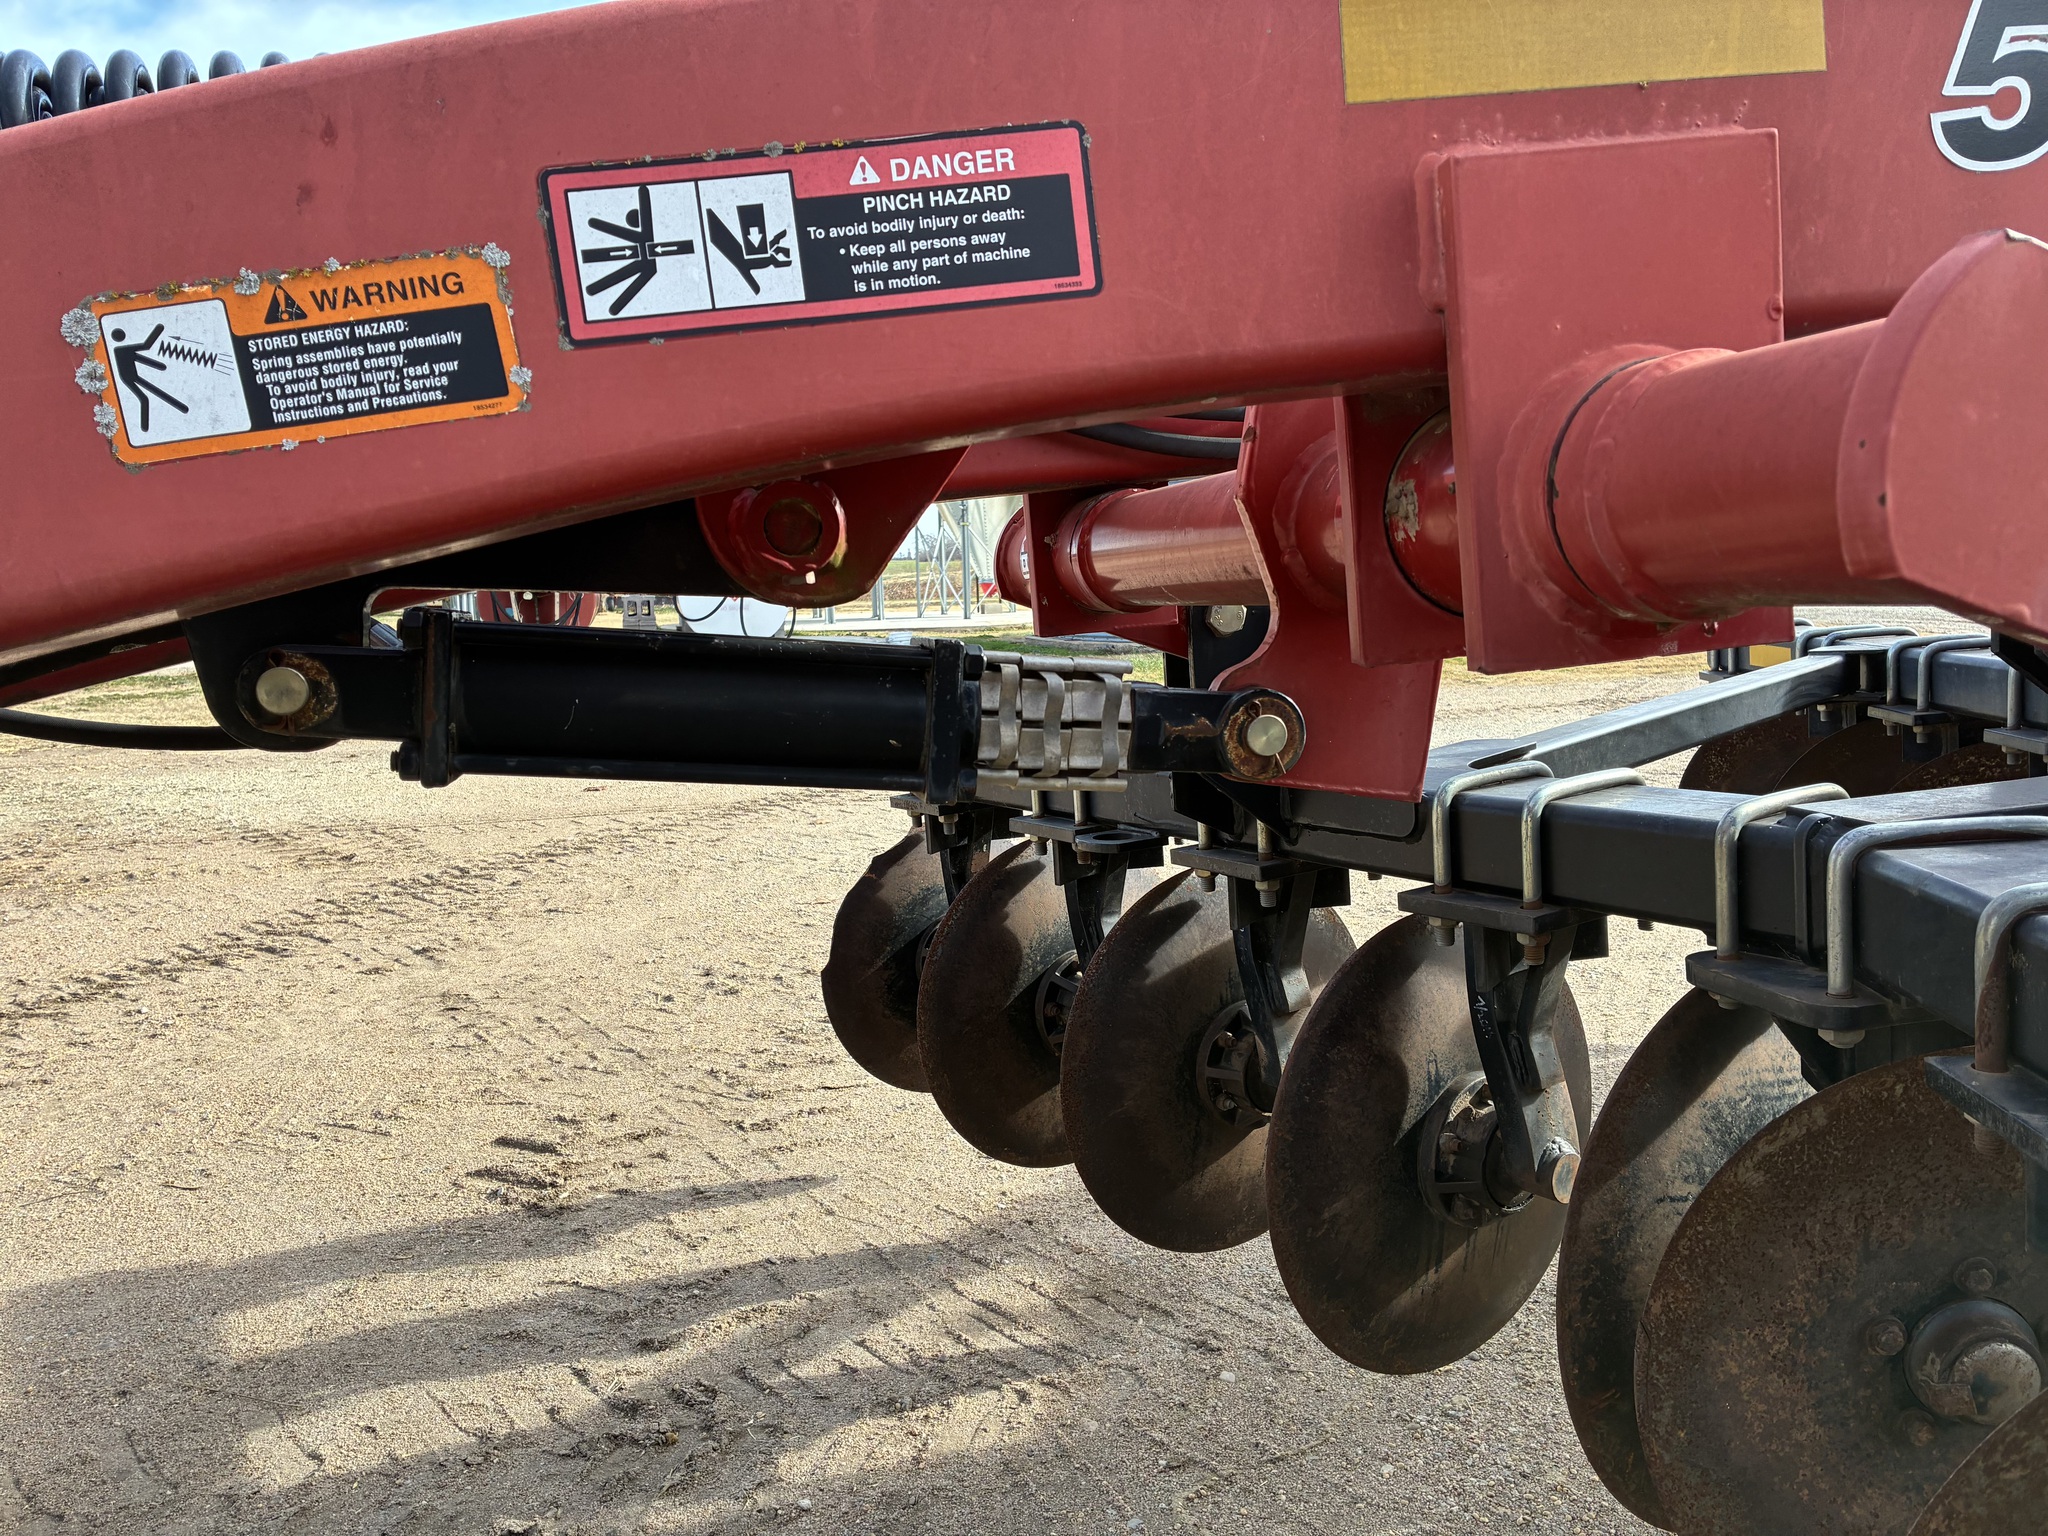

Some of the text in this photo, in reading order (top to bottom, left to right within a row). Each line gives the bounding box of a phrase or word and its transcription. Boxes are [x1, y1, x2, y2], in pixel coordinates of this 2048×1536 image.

[1930, 0, 2048, 171] 5
[890, 148, 1015, 181] DANGER
[863, 184, 1010, 213] PINCH HAZARD
[807, 207, 1025, 239] To avoid bodily injury or death:
[849, 232, 1006, 257] Keep all persons away
[852, 247, 1030, 274] while any part of machine
[309, 272, 464, 312] WARNING
[854, 274, 941, 292] is in motion.
[248, 319, 409, 352] STORED ENERGY HAZARD:
[252, 331, 462, 371] Spring assemblies have potentially
[256, 354, 408, 384] dangerous stored energy.
[266, 360, 459, 396] To avoid bodily injury, read your
[270, 375, 448, 411] Operator's Manual for Service
[273, 390, 447, 423] Instructions and Precautions.
